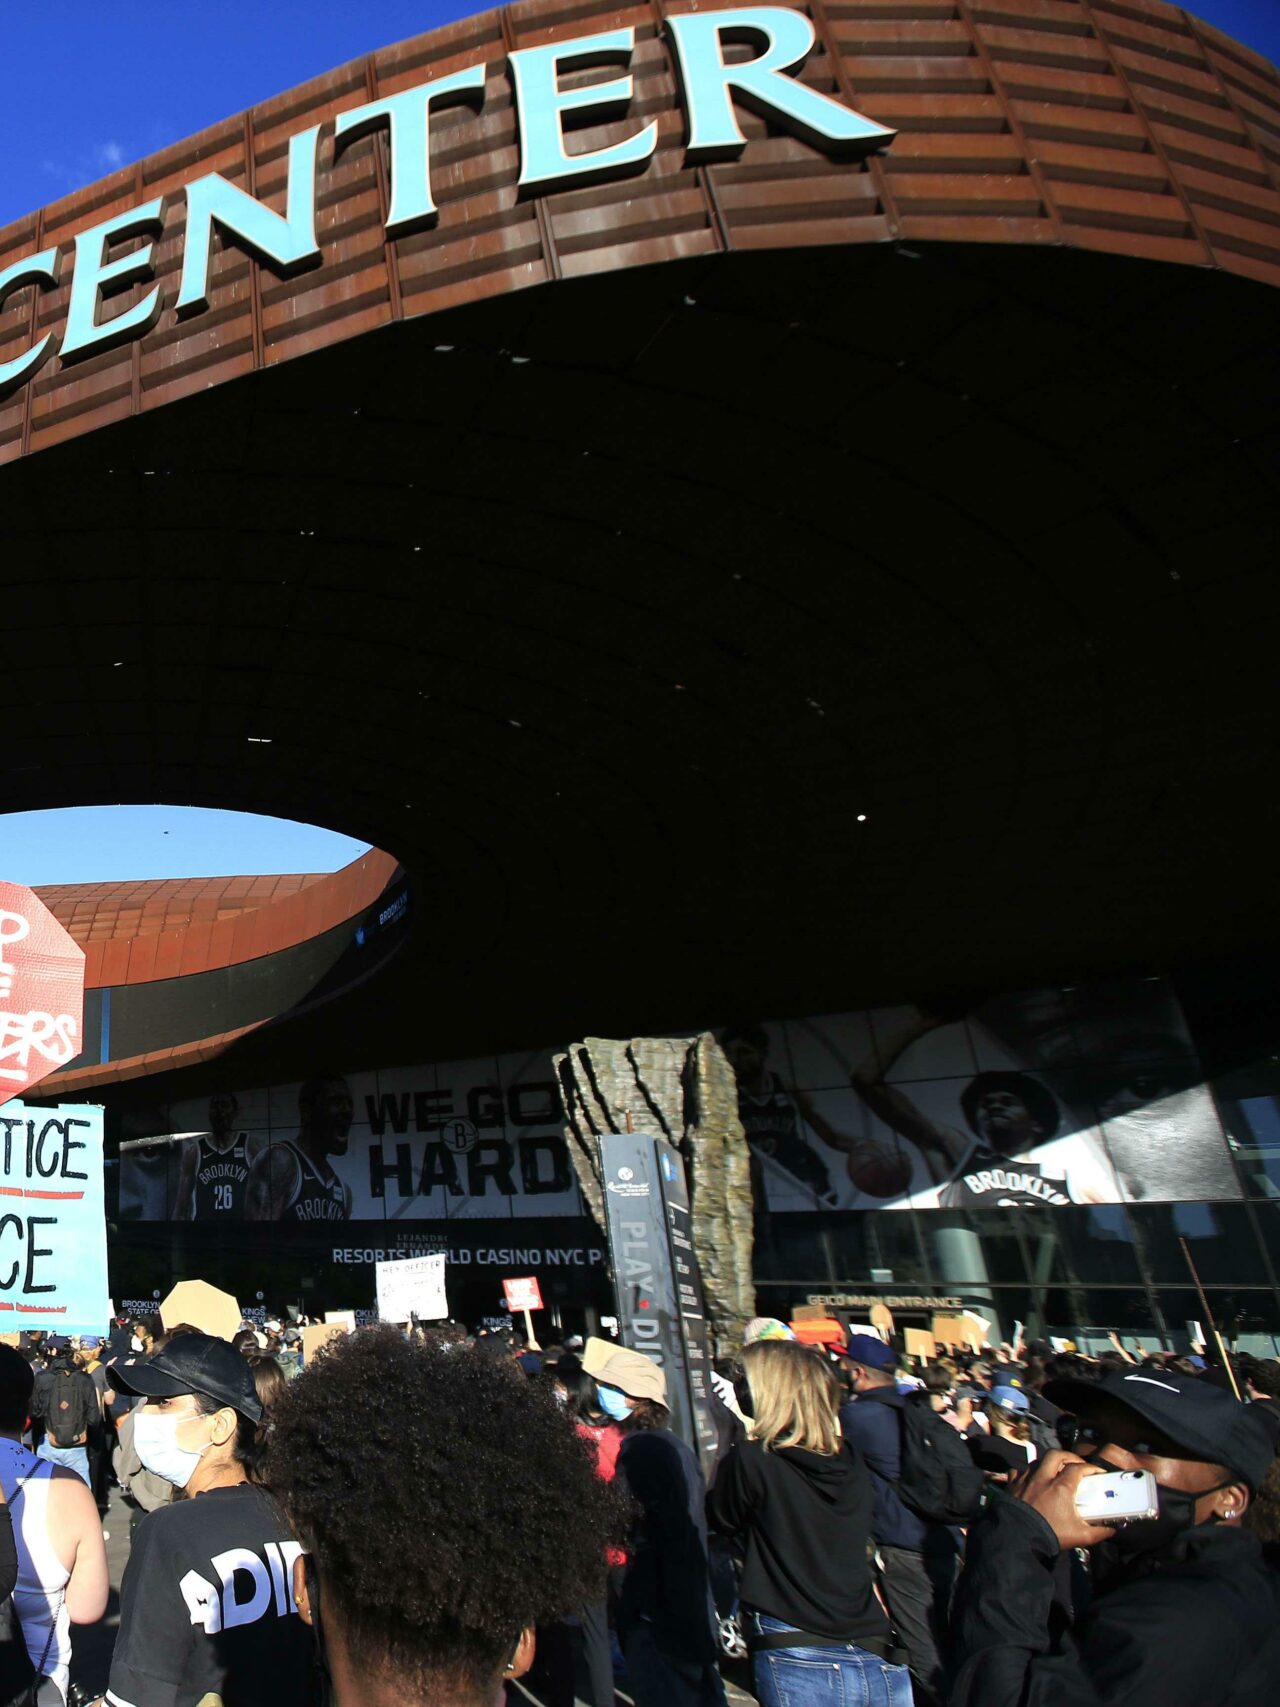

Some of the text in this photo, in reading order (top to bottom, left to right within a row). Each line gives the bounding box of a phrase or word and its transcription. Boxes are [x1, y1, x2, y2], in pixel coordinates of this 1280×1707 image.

[365, 1081, 564, 1136] WE GO
[198, 1163, 249, 1185] BROOKLYN
[369, 1135, 572, 1198] HARD
[214, 1184, 233, 1210] 26
[332, 1249, 407, 1264] RESORTS
[476, 1249, 548, 1265] CASINO
[553, 1249, 585, 1265] NYC
[620, 1221, 654, 1295] PLAY
[121, 1300, 160, 1308] BROOKLYN
[807, 1295, 845, 1306] GEICO
[886, 1296, 963, 1308] ENTRANCE
[241, 1307, 266, 1316] KINGS
[483, 1317, 512, 1327] KINGS
